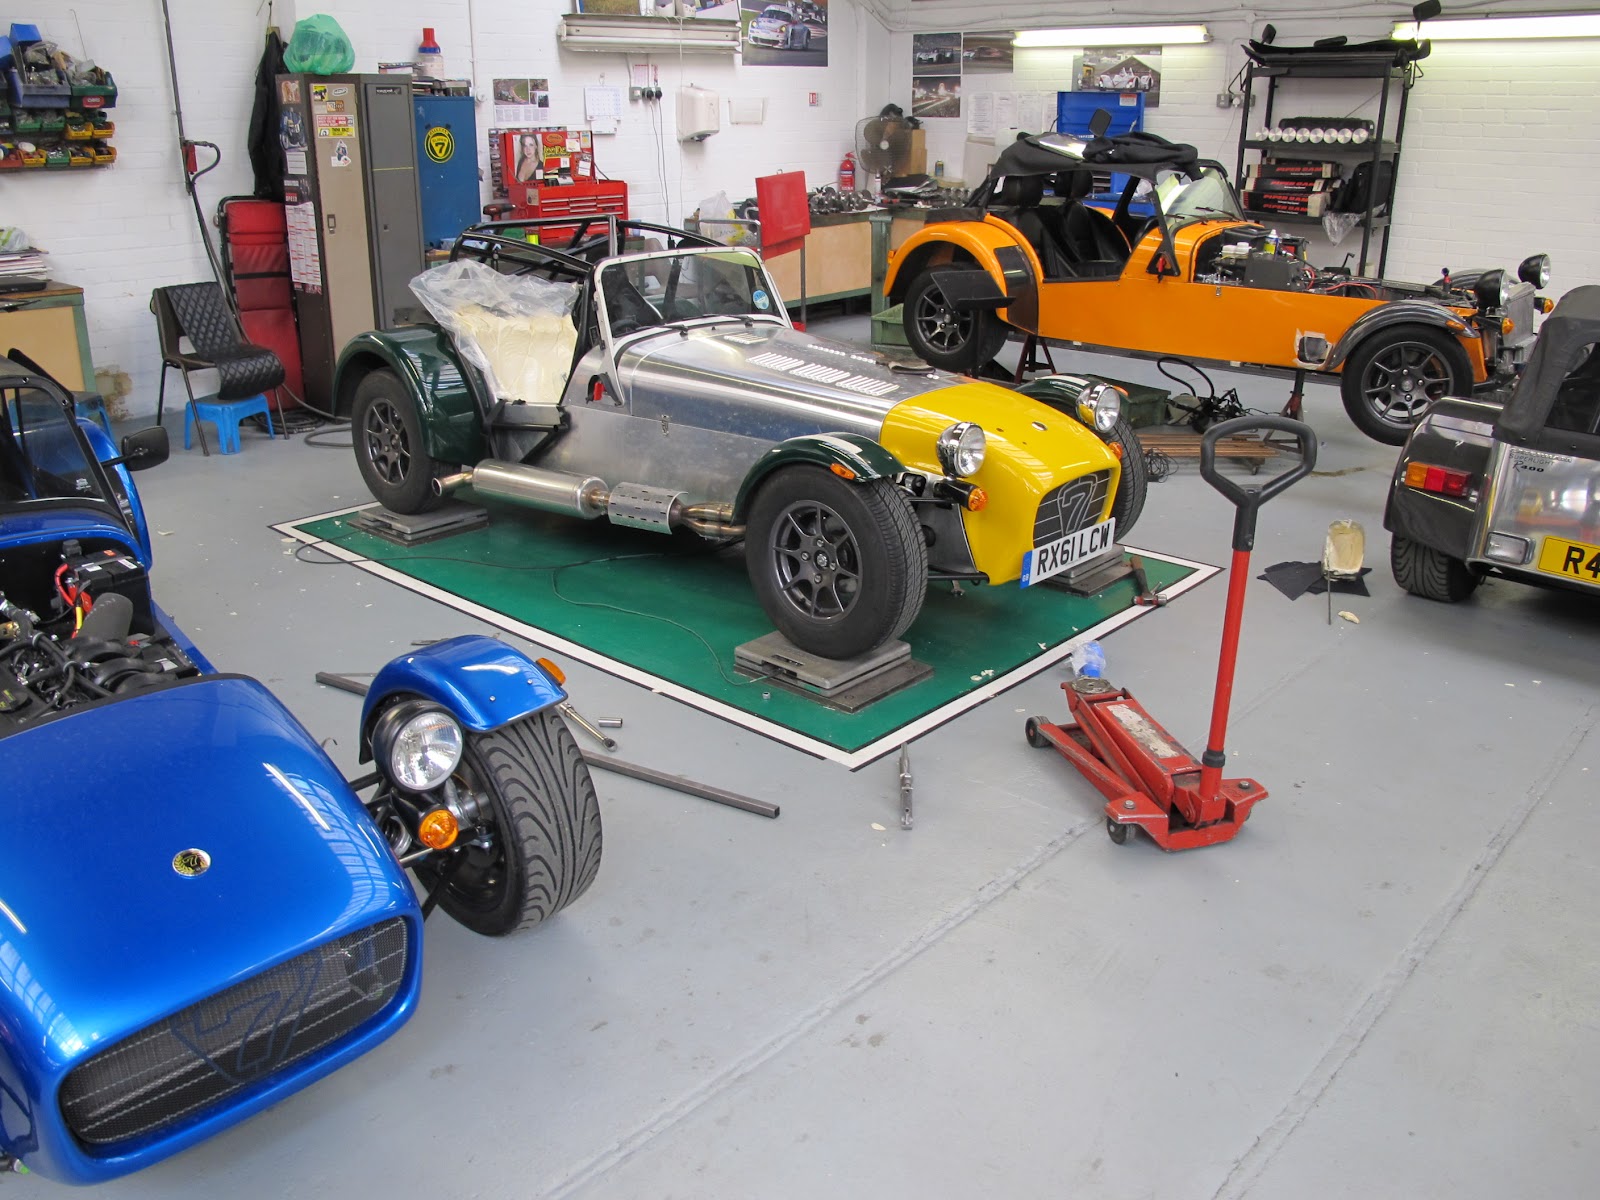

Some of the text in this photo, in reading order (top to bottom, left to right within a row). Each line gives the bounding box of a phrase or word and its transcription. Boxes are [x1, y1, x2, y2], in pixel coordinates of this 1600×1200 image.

[1508, 453, 1556, 466] SUPERLIGHT
[1512, 460, 1545, 473] R400
[1037, 523, 1111, 576] RX61 LCW
